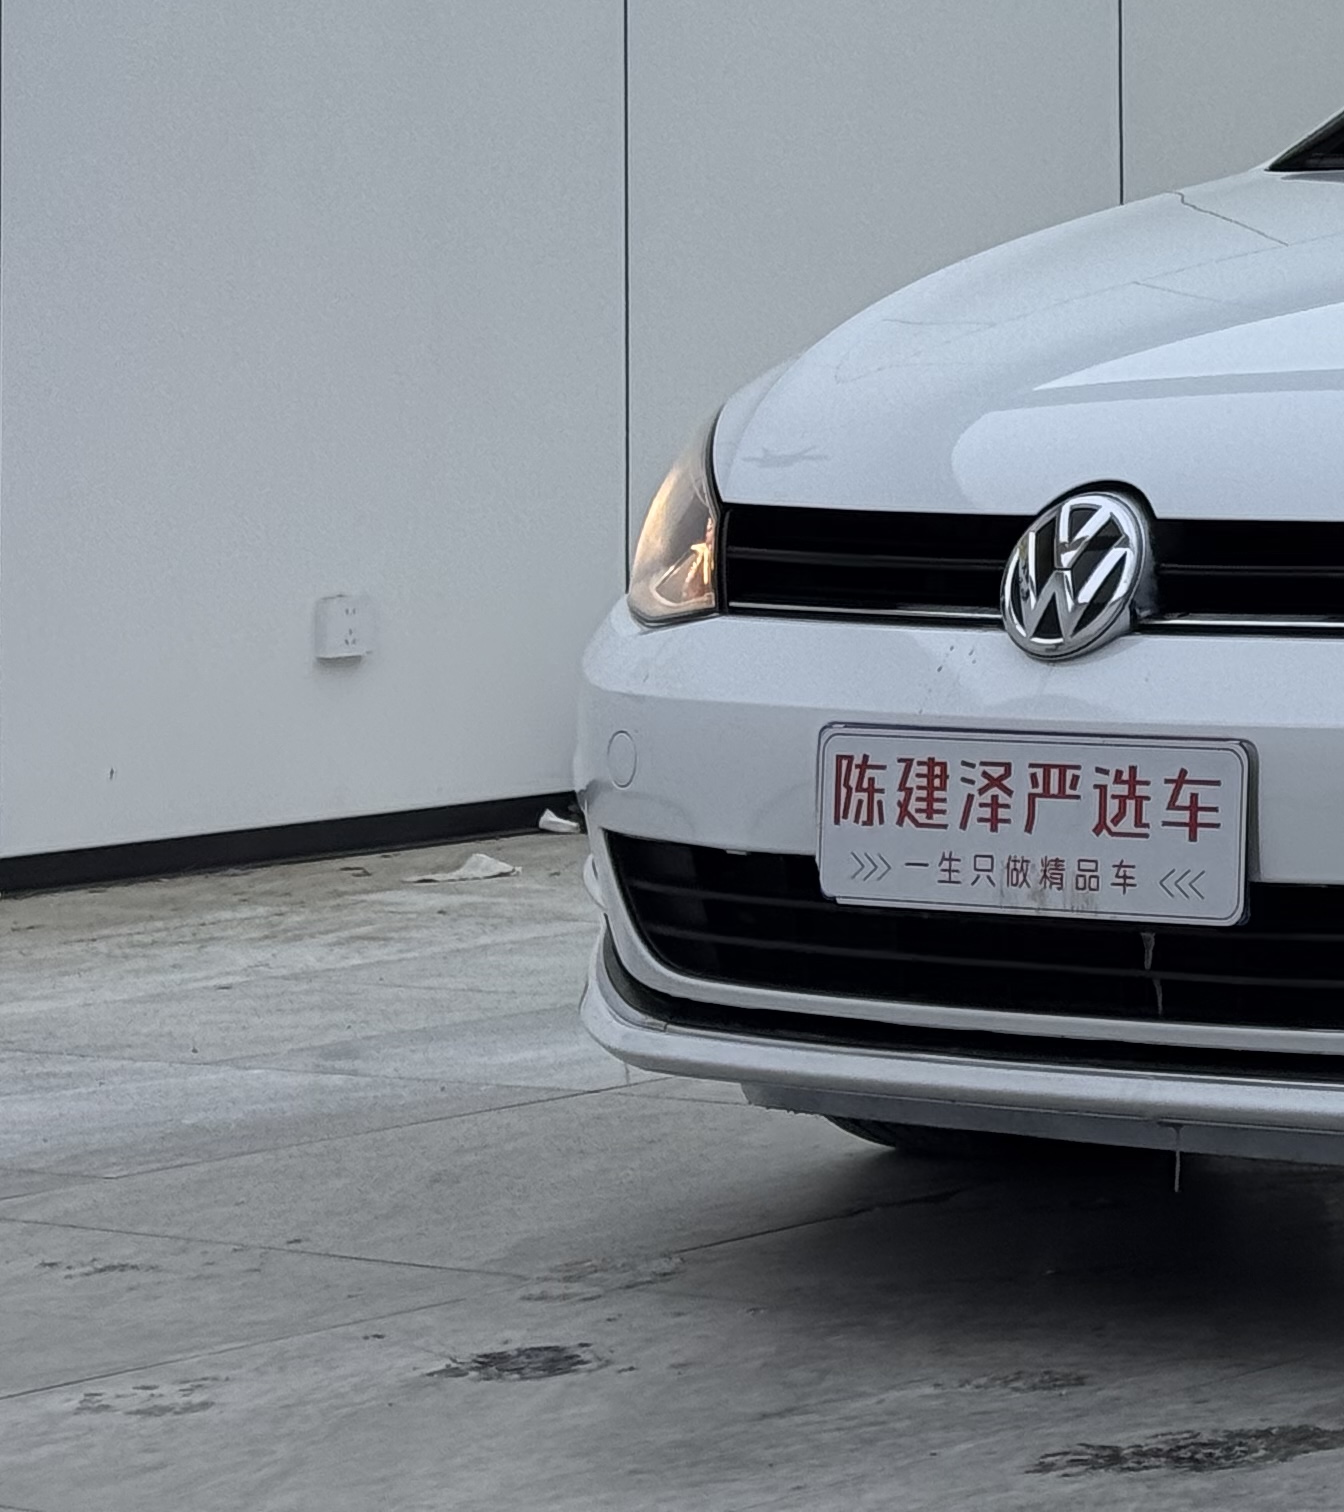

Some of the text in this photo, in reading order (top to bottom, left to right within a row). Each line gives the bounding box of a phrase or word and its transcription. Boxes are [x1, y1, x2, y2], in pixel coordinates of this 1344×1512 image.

[833, 753, 1223, 843] 陈建泽严选车
[904, 850, 1138, 895] 一生只做精品车
